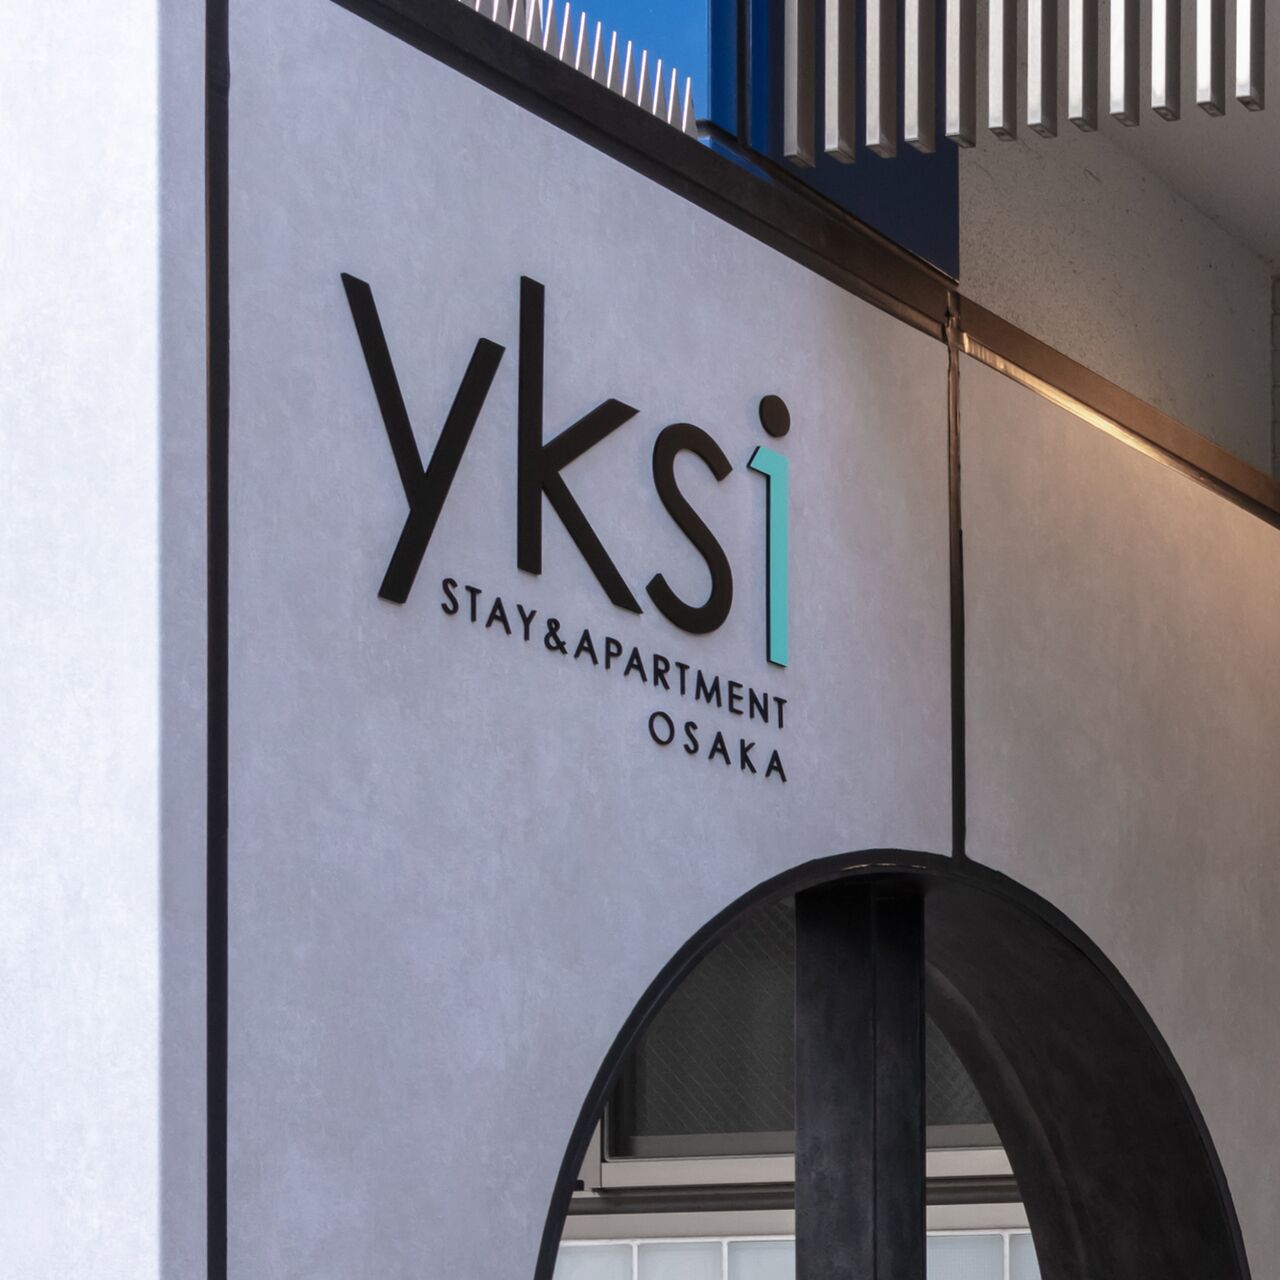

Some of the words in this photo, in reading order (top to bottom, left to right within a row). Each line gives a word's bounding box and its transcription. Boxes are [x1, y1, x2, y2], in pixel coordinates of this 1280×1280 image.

[340, 272, 790, 667] yksi
[440, 577, 788, 729] STAY&APARTMENT
[648, 711, 788, 782] OSAKA
